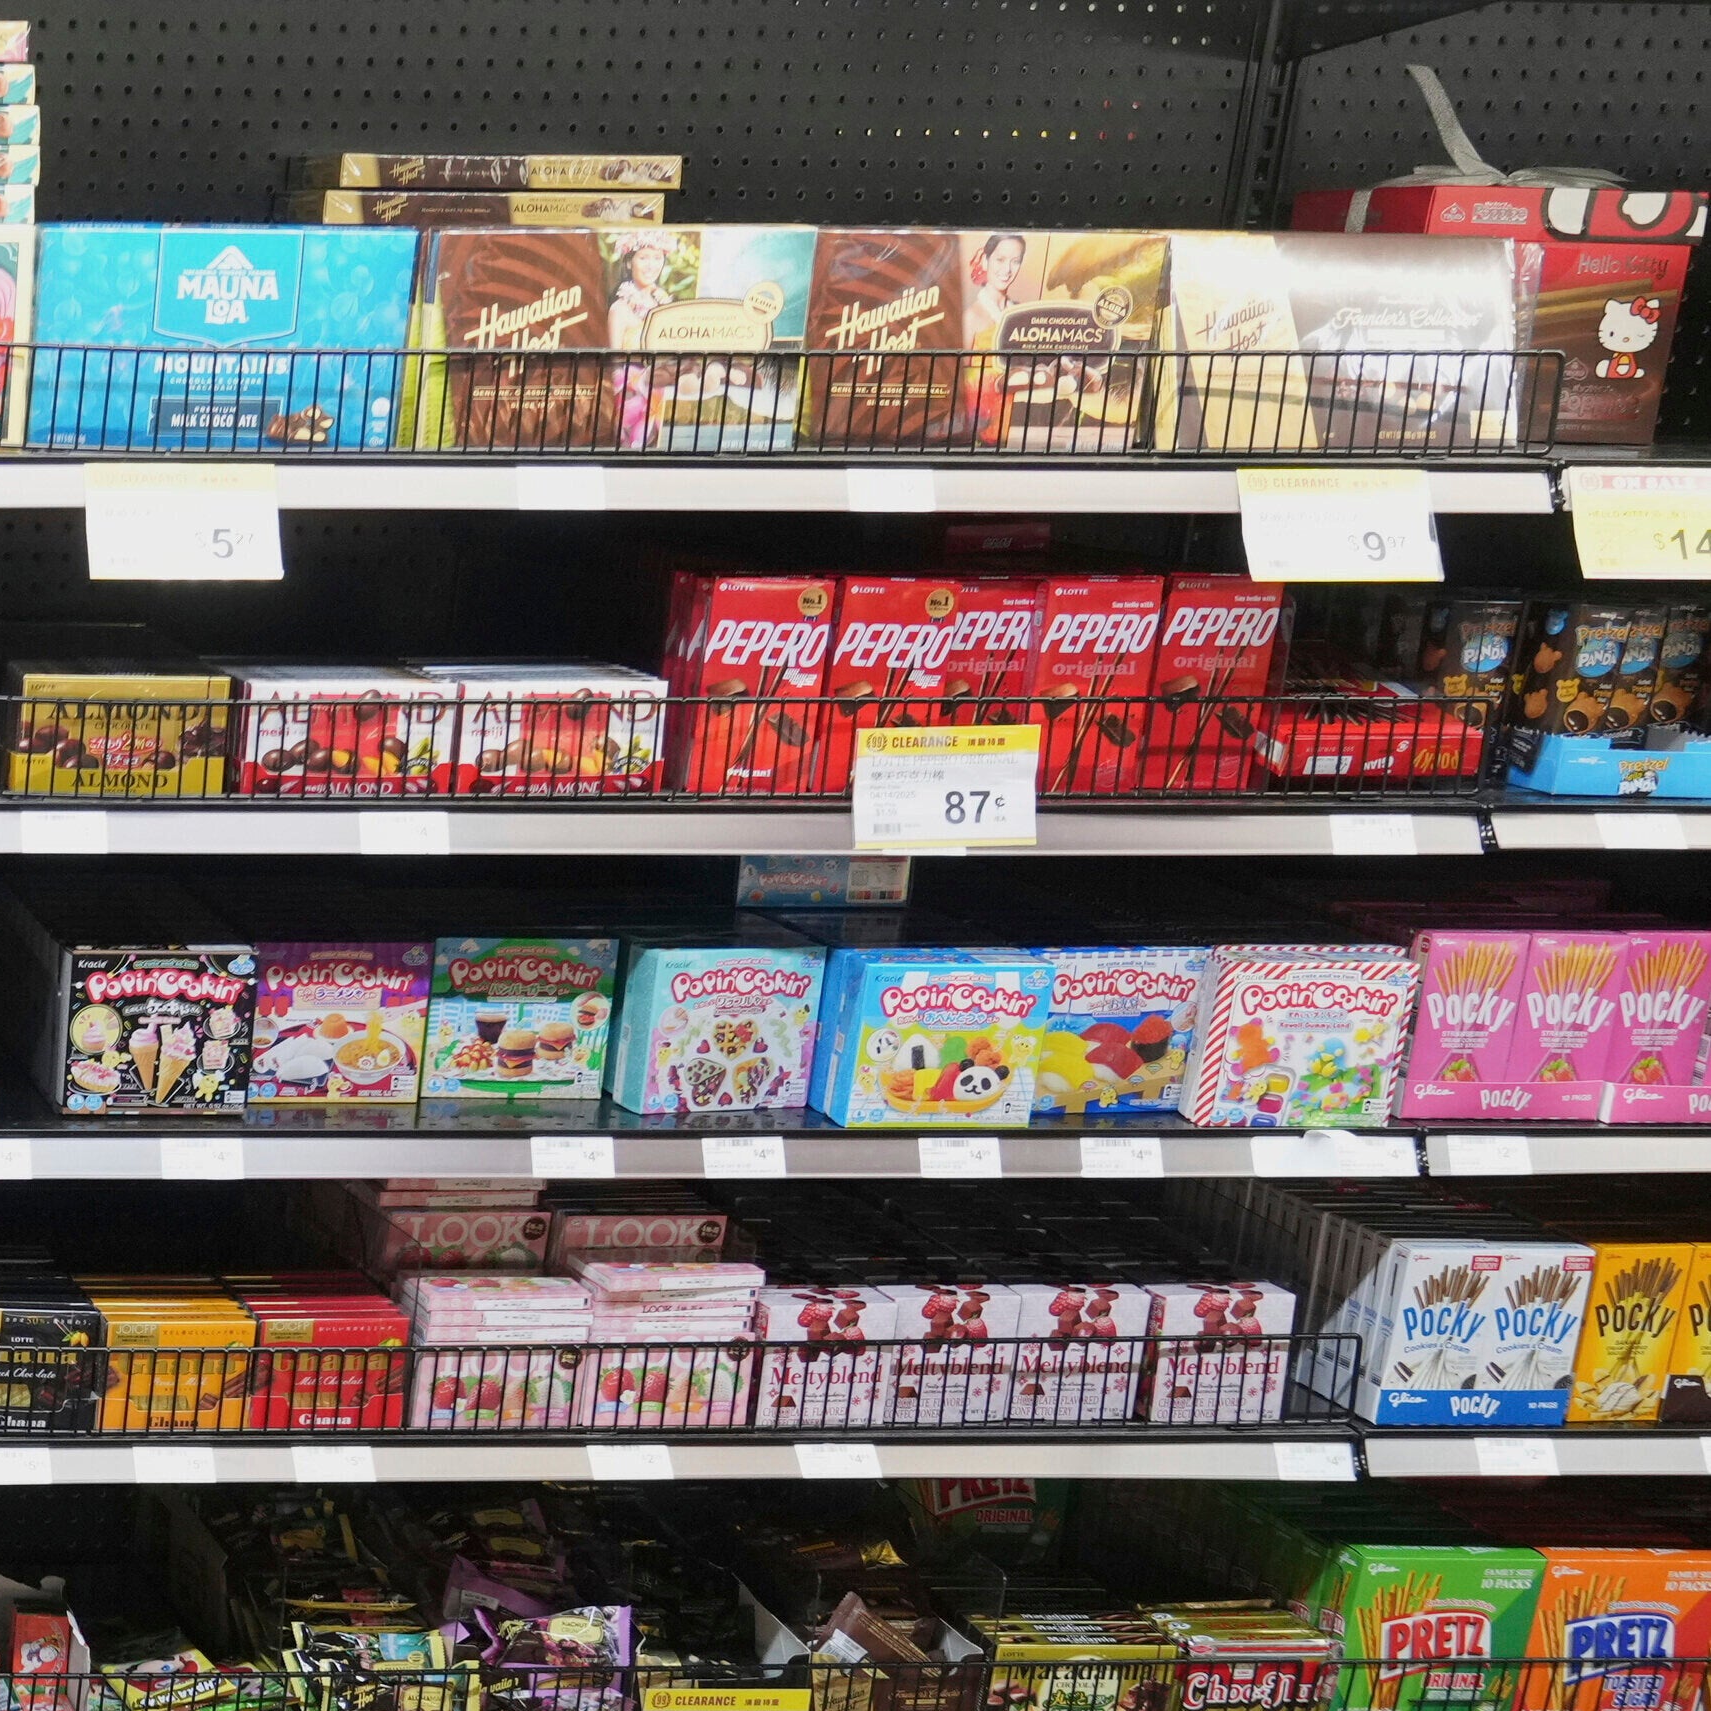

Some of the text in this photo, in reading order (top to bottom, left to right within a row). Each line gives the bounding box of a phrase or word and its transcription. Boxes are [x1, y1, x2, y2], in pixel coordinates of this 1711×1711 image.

[1577, 254, 1671, 279] Hello Kitty
[176, 276, 279, 302] MAUNA
[205, 299, 247, 325] LOA
[1041, 612, 1159, 656] PEPERO
[1163, 606, 1280, 648] PEPERO
[705, 619, 830, 668] PEPERO
[833, 622, 955, 669] PEPERO
[891, 735, 959, 749] CLEARANCE
[70, 770, 169, 791] ALMOND
[770, 1361, 882, 1388] Meltyblend
[1165, 1355, 1280, 1380] Meltyblend
[1388, 1392, 1428, 1406] Glico
[1388, 1615, 1486, 1668] PRETZ
[1568, 1616, 1669, 1664] PRETZ
[674, 1694, 737, 1708] CLEARANCE
